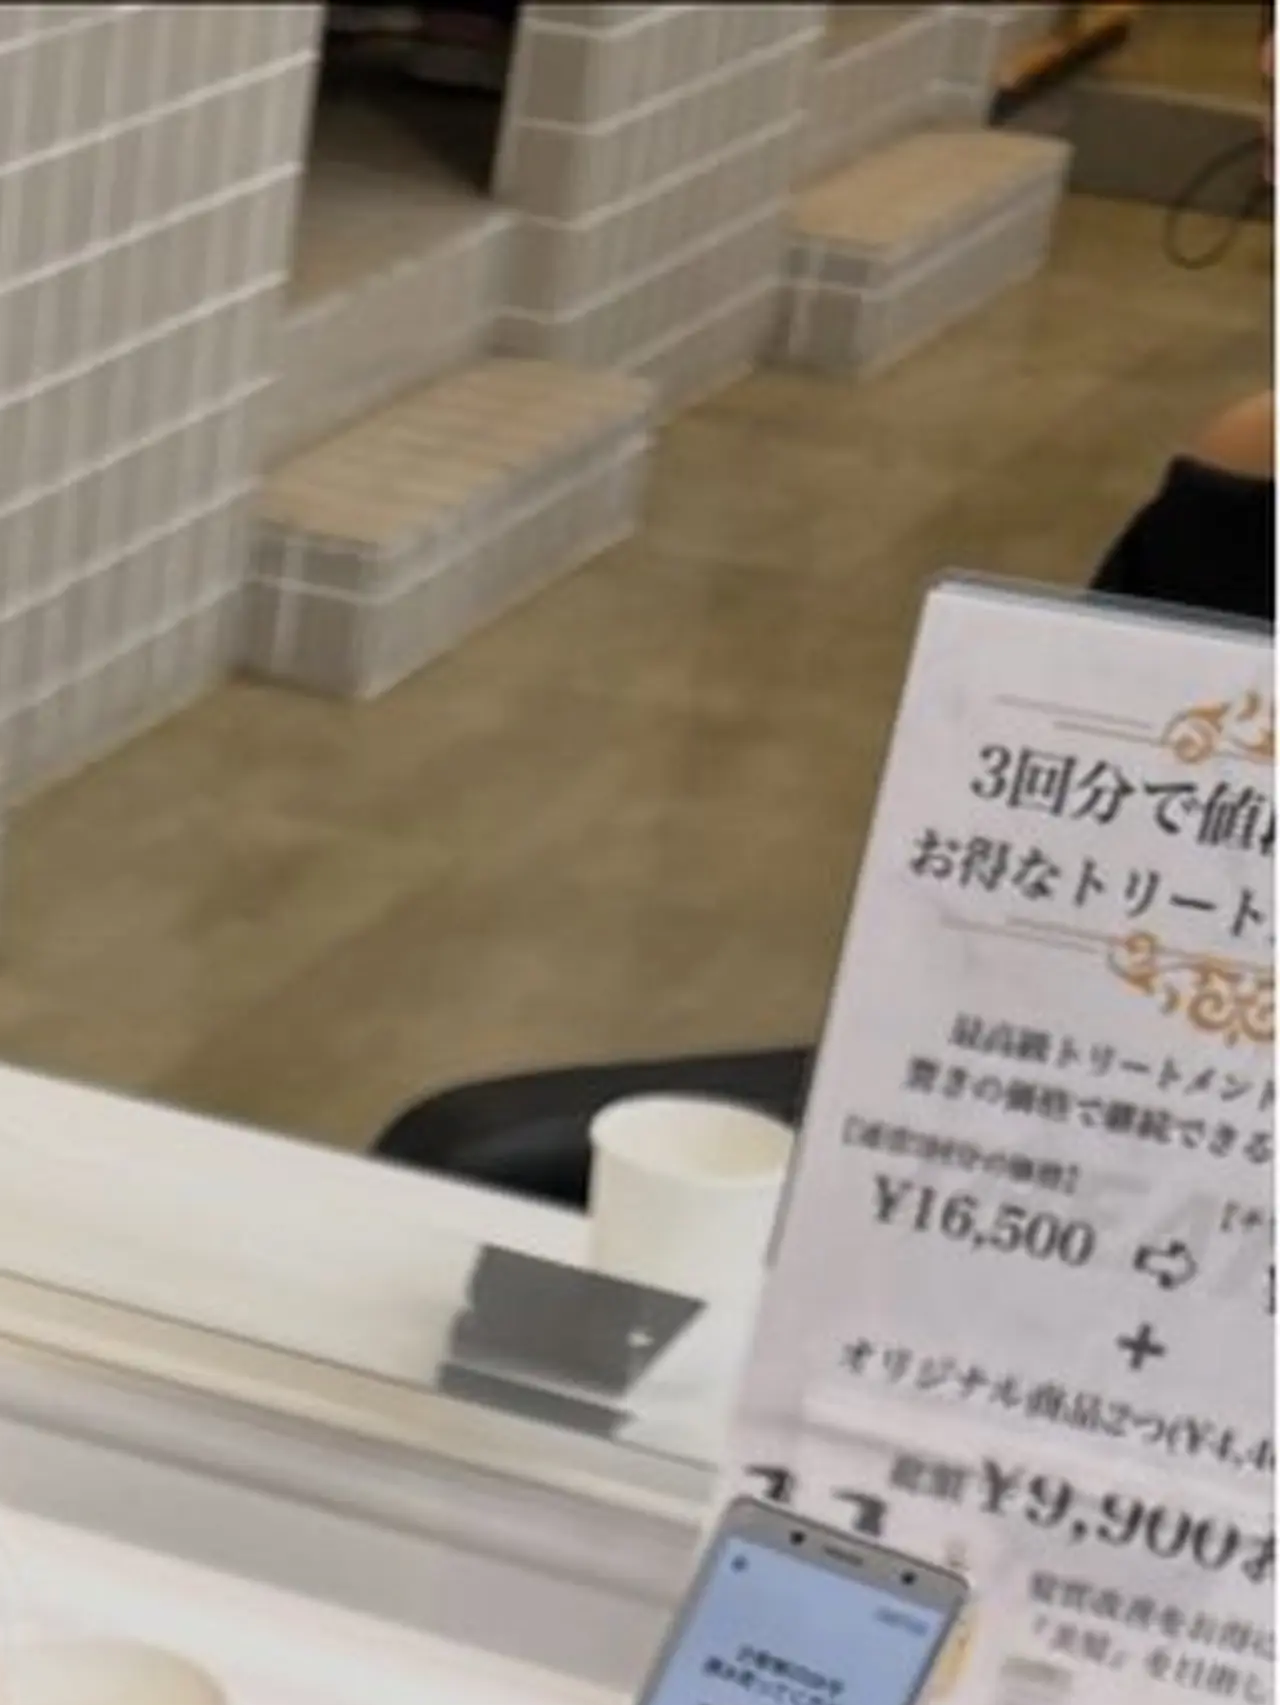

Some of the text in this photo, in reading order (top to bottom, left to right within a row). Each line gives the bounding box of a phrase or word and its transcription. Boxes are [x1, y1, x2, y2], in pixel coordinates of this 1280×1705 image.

[970, 745, 1274, 857] 3回分で値
[910, 828, 1274, 942] お得なトリート
[841, 1338, 1274, 1474] オリジナル商品2つ(¥4,4
